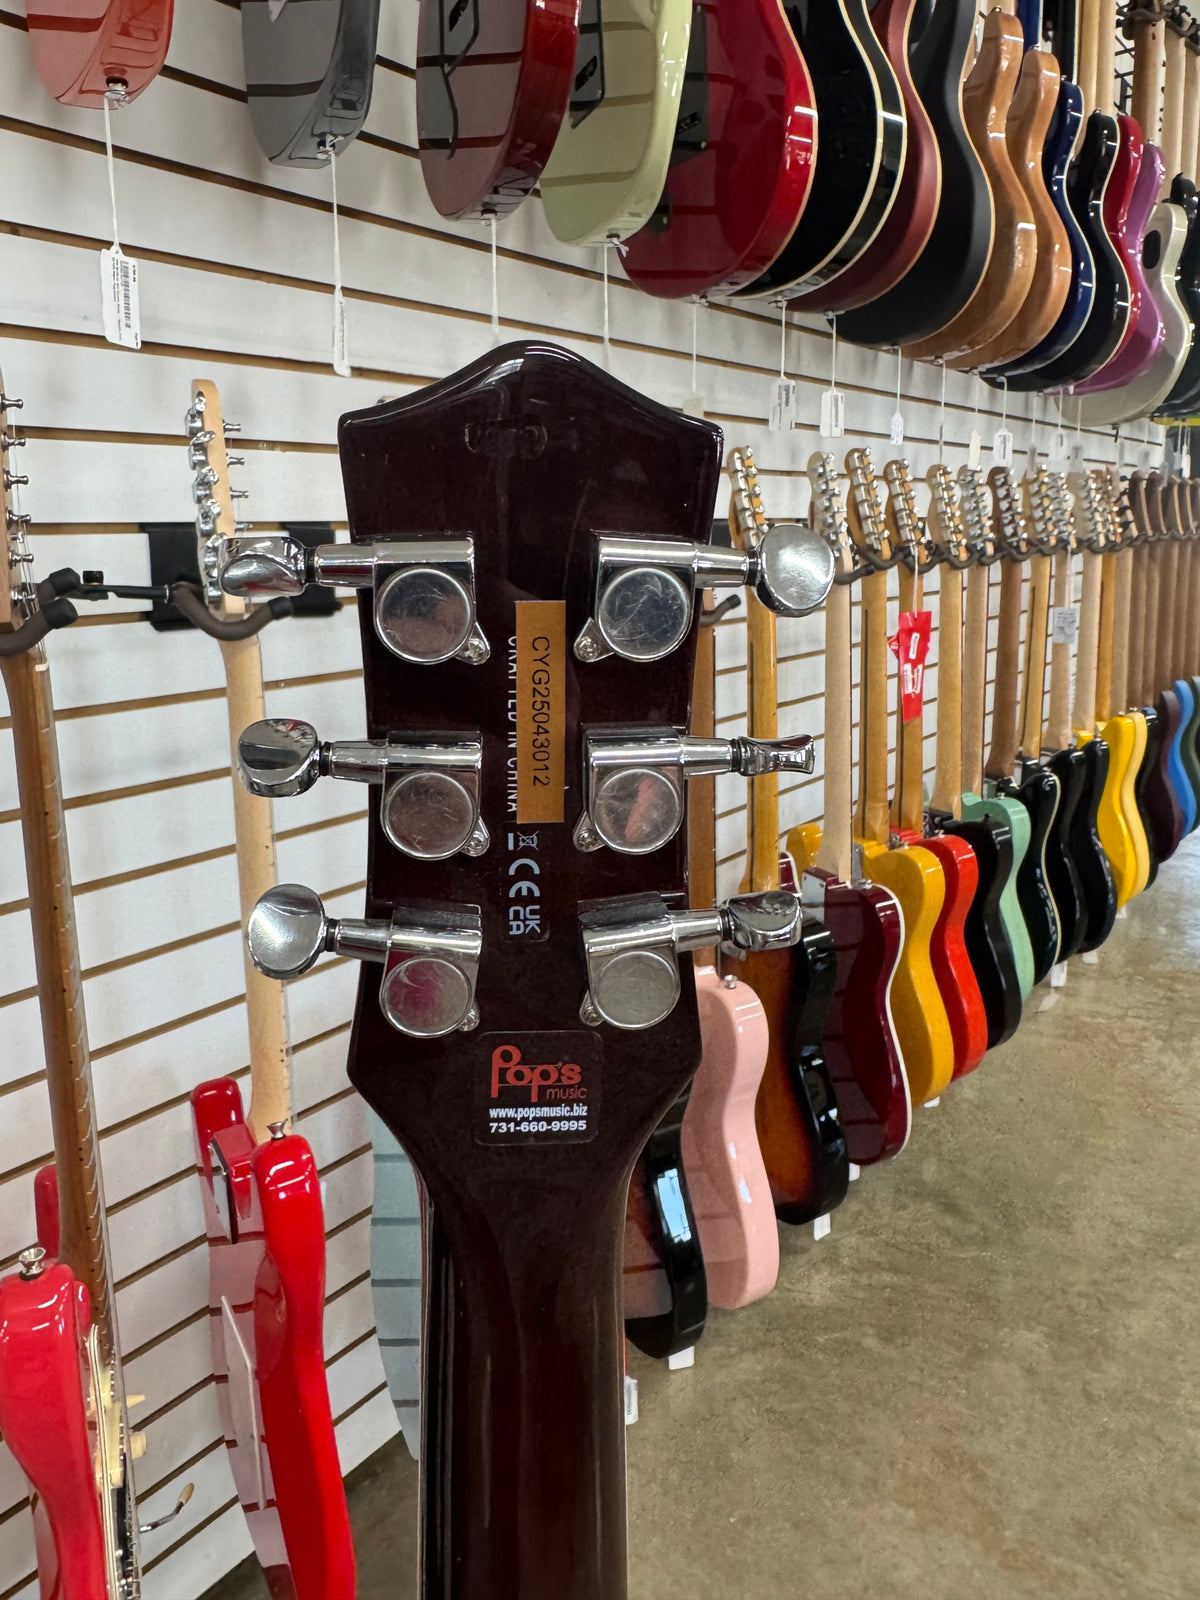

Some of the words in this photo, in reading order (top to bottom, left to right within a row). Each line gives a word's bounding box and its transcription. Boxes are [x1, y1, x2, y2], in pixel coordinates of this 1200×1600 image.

[531, 636, 550, 786] CYG25043012
[490, 1044, 582, 1103] Pop's
[546, 1084, 588, 1100] music
[489, 1103, 588, 1121] www.popsmusic.biz
[488, 1120, 587, 1133] 731-660-9995
